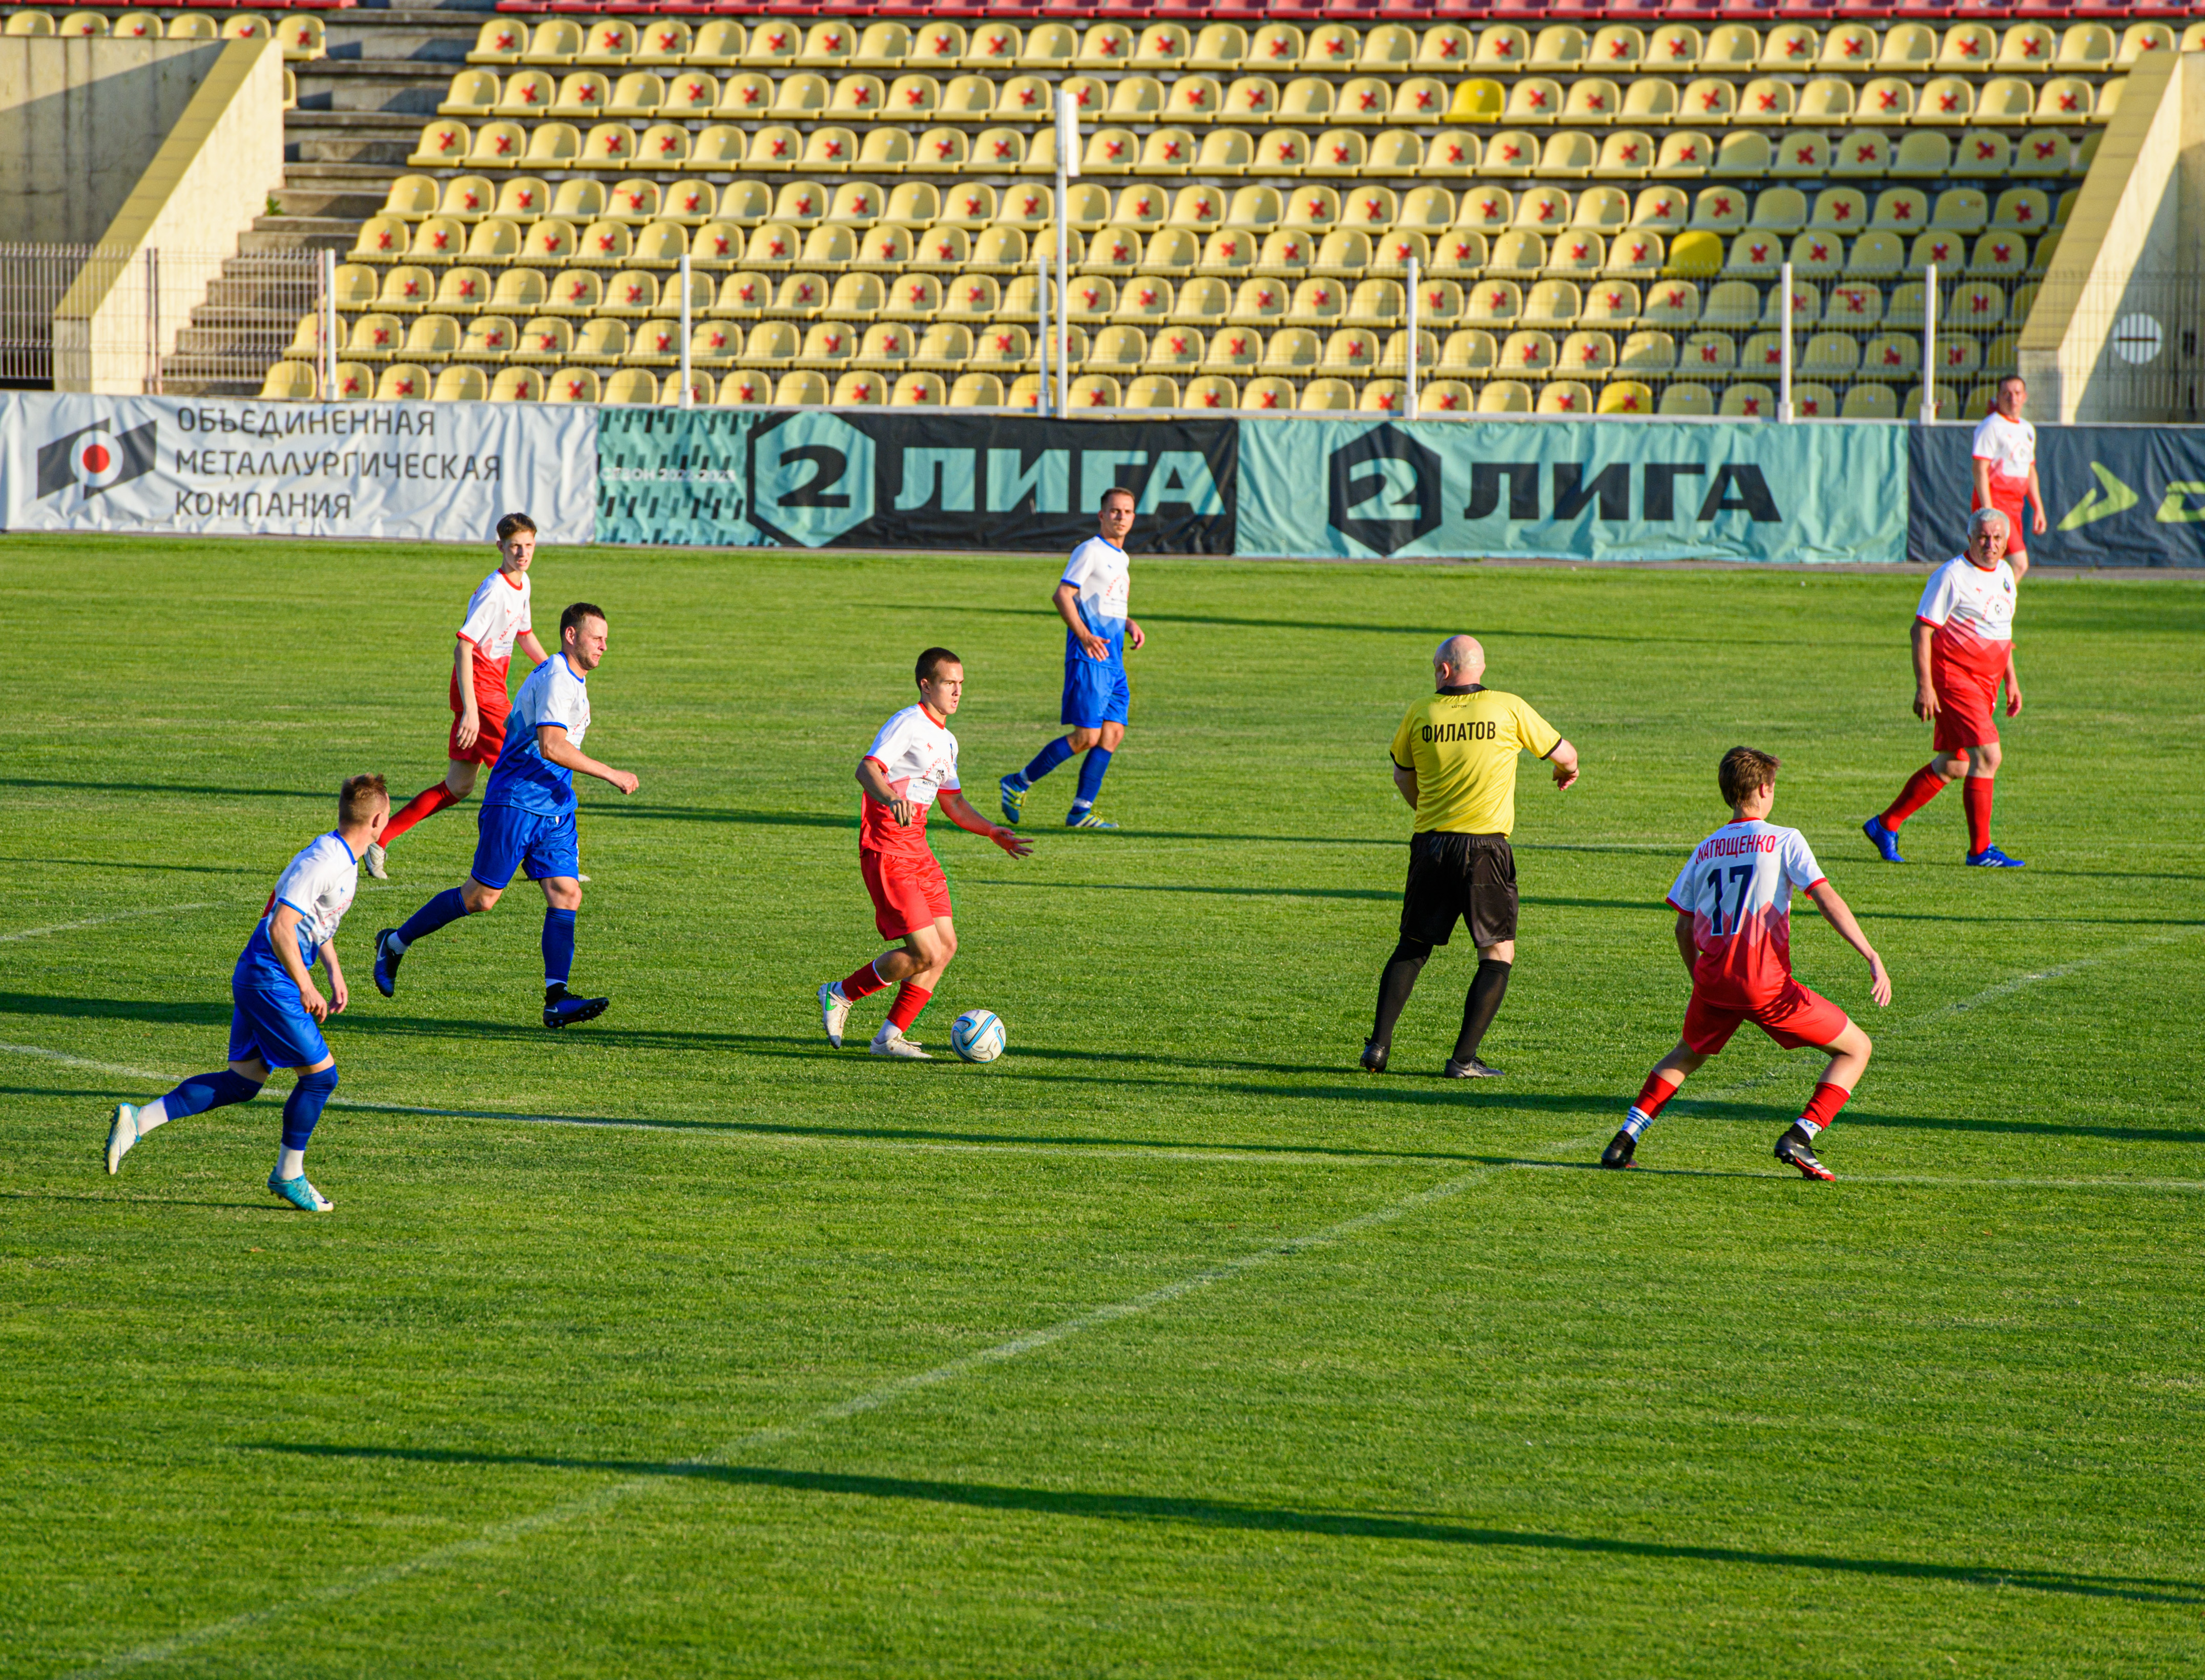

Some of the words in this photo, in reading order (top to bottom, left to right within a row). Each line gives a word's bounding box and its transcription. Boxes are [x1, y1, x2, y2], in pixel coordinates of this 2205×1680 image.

[178, 406, 435, 438] ОБЪЕДИНЕННАЯ
[176, 449, 501, 481] МЕТАЛЛУРГИЧЕСКАЯ
[600, 467, 655, 481] СЕЗОН
[777, 445, 851, 508] 2
[894, 447, 1226, 514] ЛИГА
[175, 490, 351, 519] КОМПАНИЯ
[1347, 457, 1421, 520] 2
[1463, 462, 1783, 522] ЛИГА
[1422, 721, 1496, 743] ФИЛАТОВ
[1696, 834, 1777, 864] МАТЮЩЕНКО
[1707, 864, 1754, 936] 17
